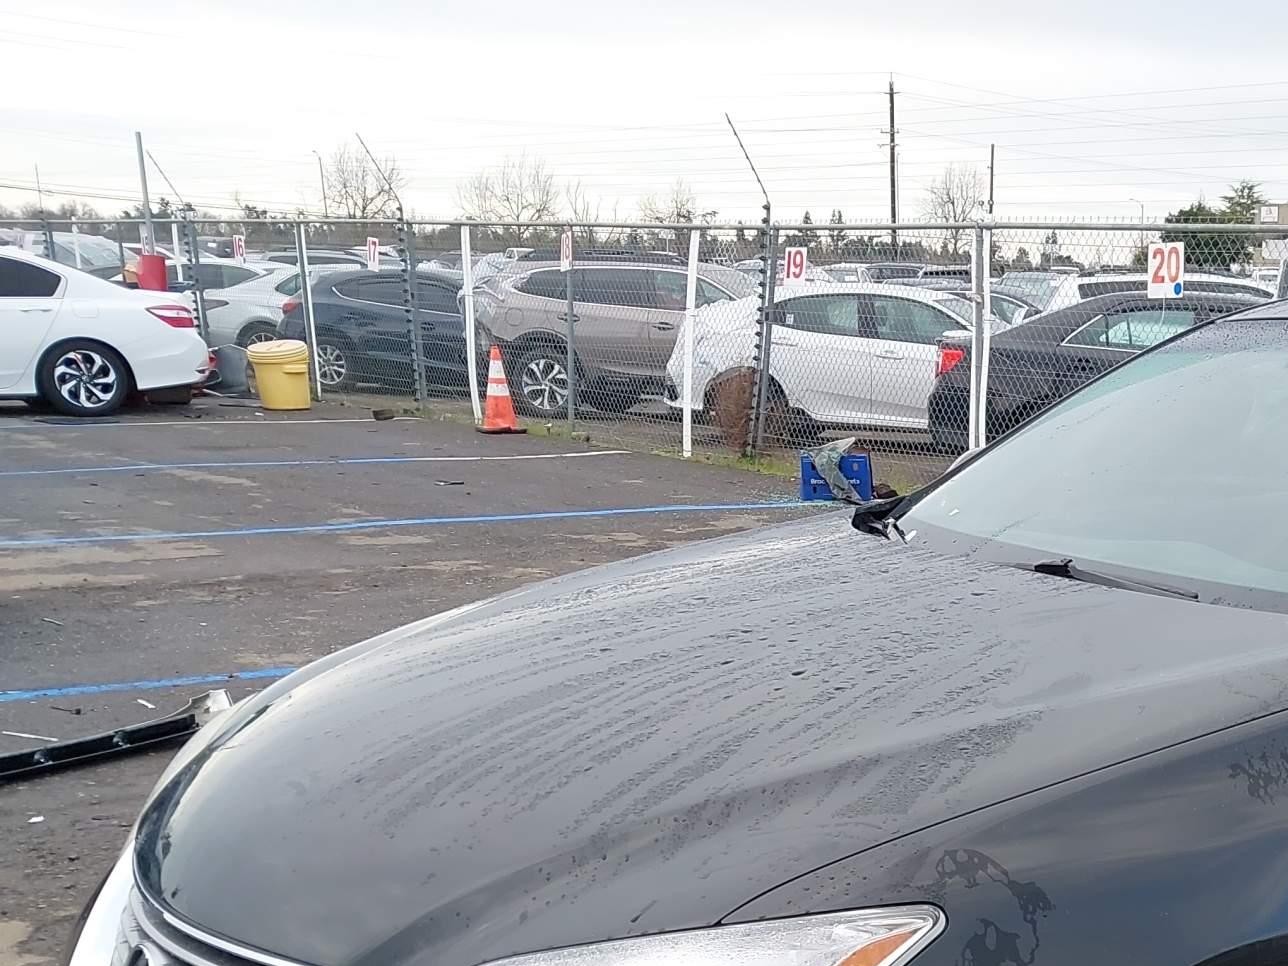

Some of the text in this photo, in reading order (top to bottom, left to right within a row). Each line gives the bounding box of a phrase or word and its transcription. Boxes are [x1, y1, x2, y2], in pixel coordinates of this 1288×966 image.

[234, 236, 244, 257] 16
[368, 239, 377, 262] 17
[561, 232, 571, 261] 18
[785, 249, 804, 279] 19
[1151, 246, 1180, 284] 20
